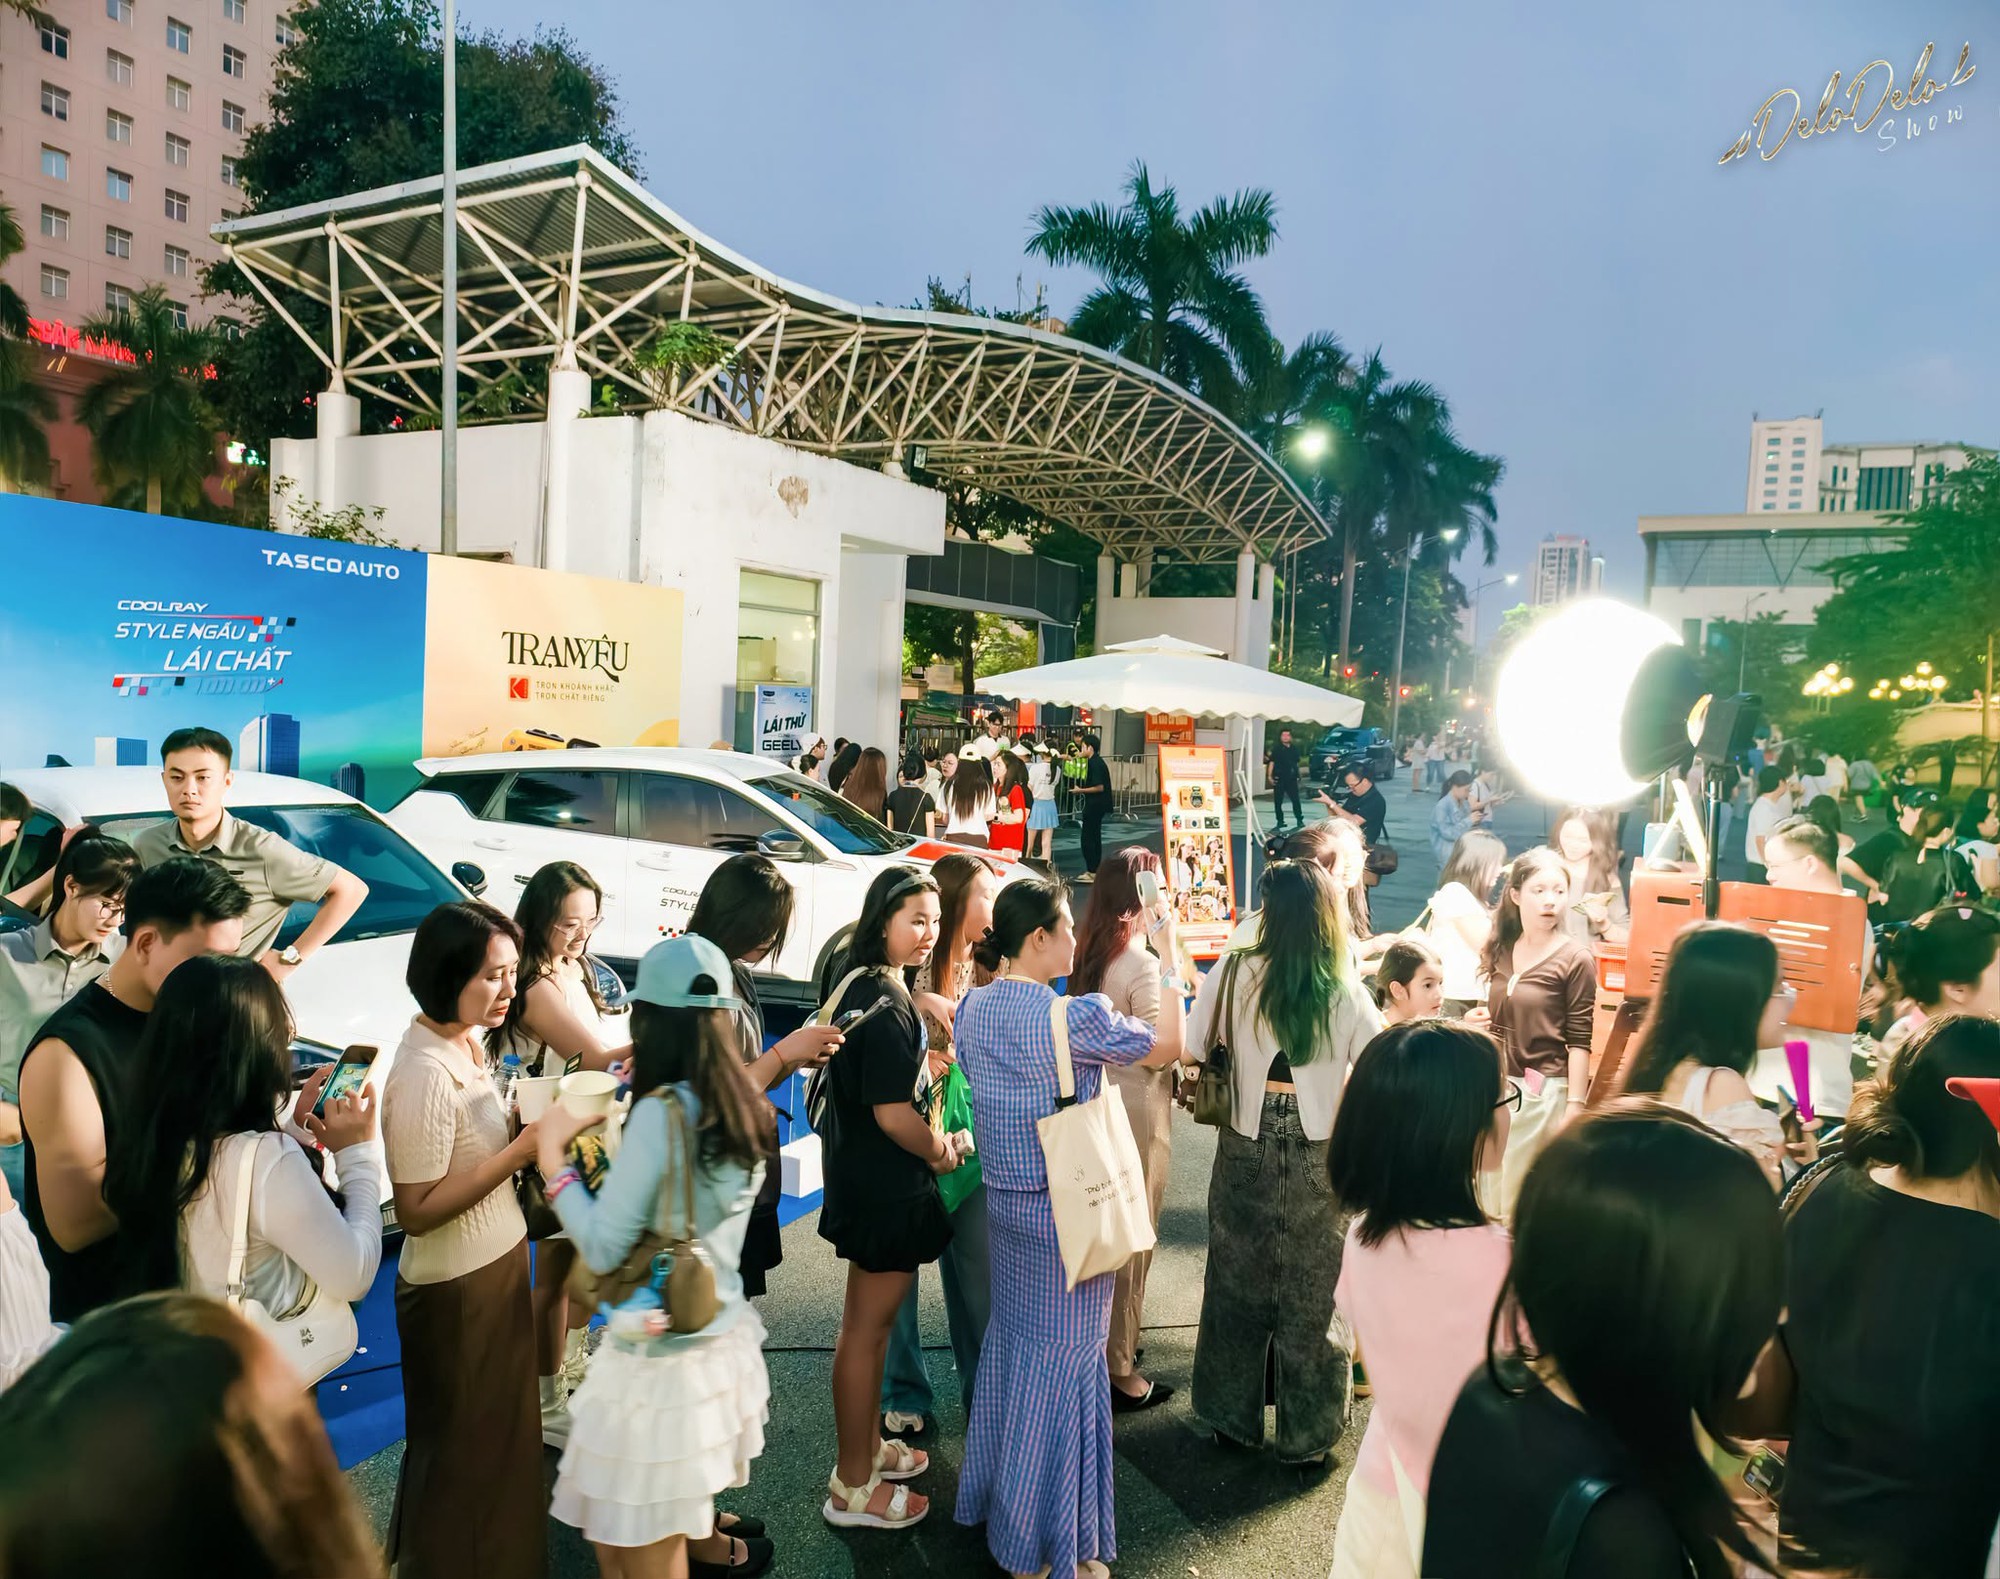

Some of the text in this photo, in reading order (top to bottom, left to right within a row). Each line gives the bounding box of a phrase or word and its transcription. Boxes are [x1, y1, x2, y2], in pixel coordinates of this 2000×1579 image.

[261, 549, 400, 580] TASCO AUTO
[117, 600, 209, 613] COOLRAY
[114, 622, 188, 639] STYLE
[163, 646, 213, 672] LÁI
[763, 715, 783, 734] LÁI
